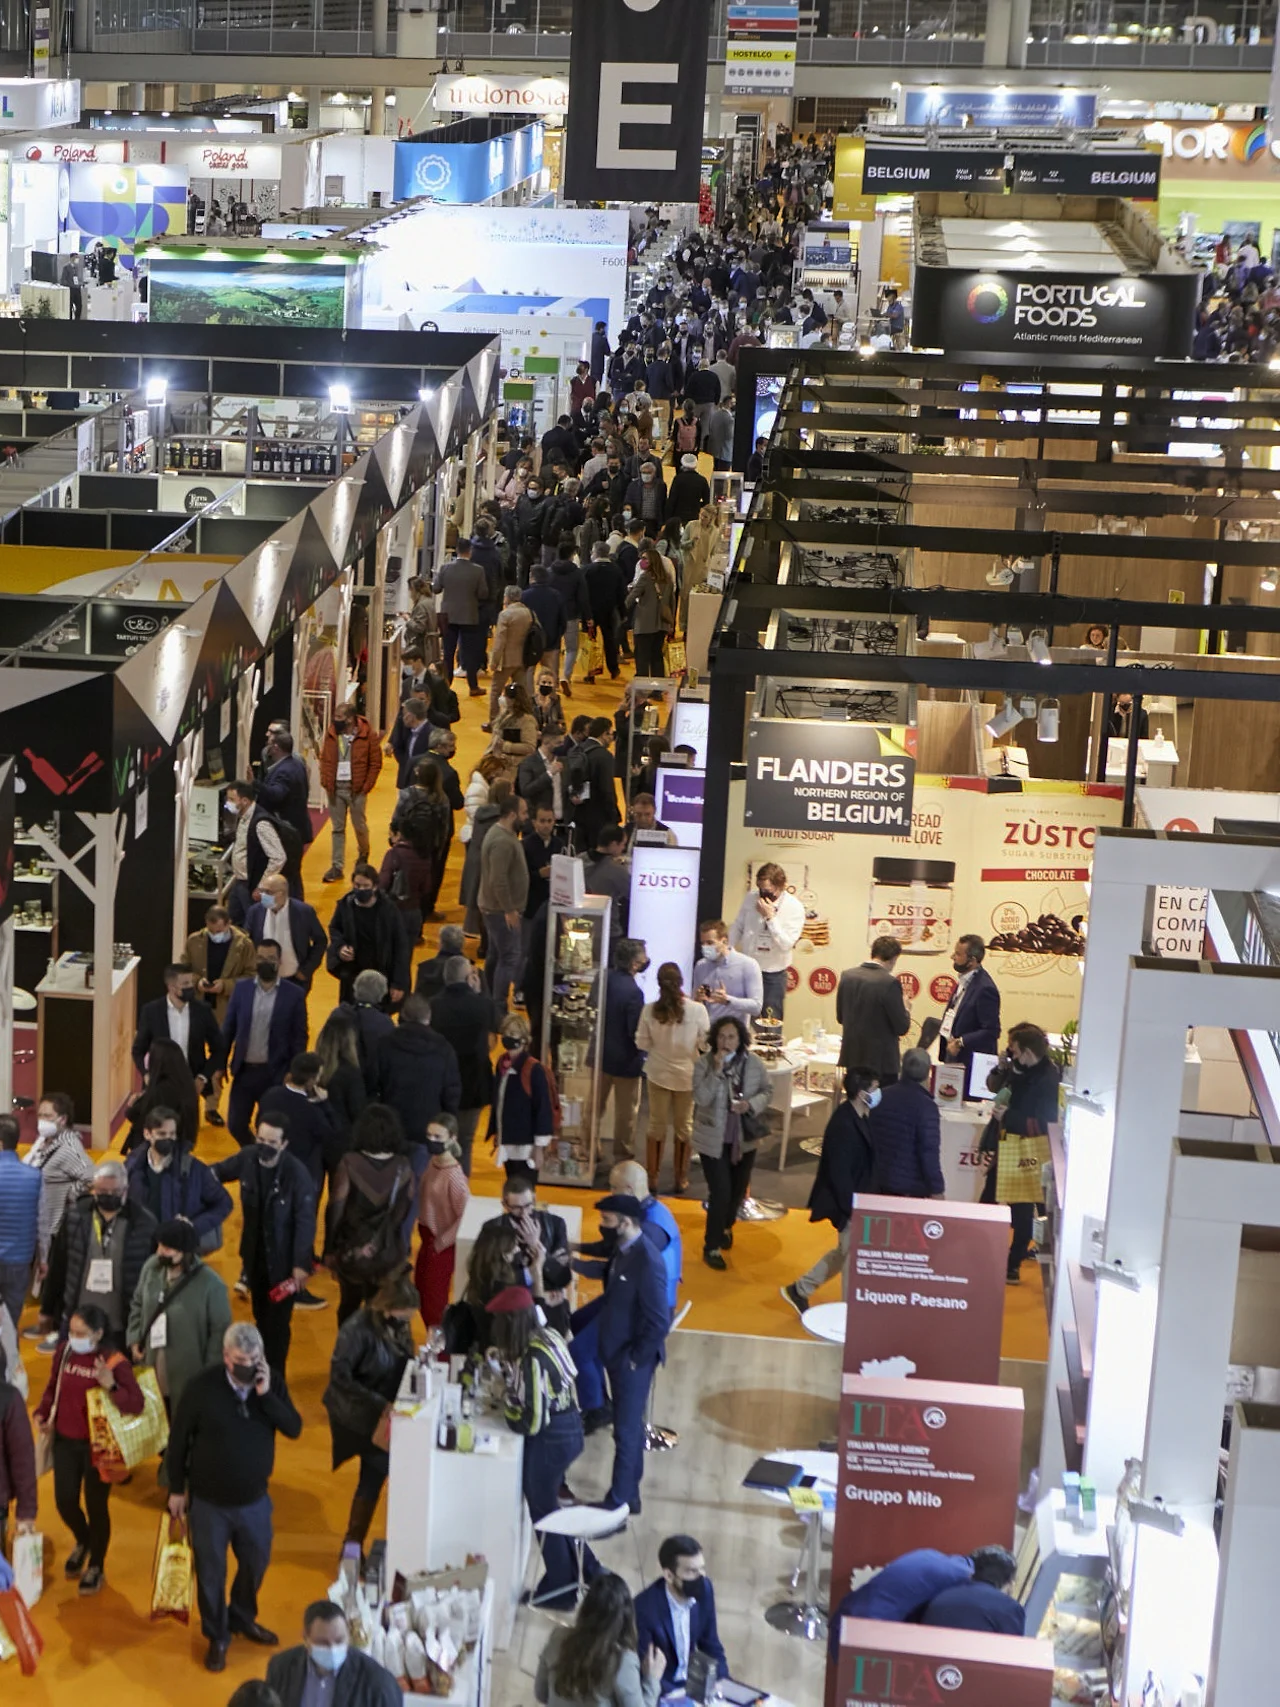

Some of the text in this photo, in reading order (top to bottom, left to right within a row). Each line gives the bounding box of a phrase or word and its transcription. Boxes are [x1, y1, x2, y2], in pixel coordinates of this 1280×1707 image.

[732, 50, 773, 58] HOSTELCO
[595, 62, 680, 171] E
[53, 144, 97, 159] Poland
[202, 148, 248, 163] Poland
[867, 166, 931, 180] BELGIUM
[1090, 171, 1156, 185] BELGIUM
[1016, 284, 1147, 308] PORTUGAL
[1014, 305, 1098, 328] FOODS
[1013, 332, 1143, 345] Atlantic meets Mediterranean
[756, 756, 907, 788] FLANDERS
[794, 787, 906, 802] NORTHERN REGION OF
[806, 802, 904, 826] BELGIUM
[914, 830, 944, 845] LOVE
[1003, 818, 1097, 849] ZÙSTO
[1001, 849, 1036, 858] SUGAR
[638, 871, 692, 889] ZÙSTO
[1025, 869, 1076, 881] CHOCOLATE
[1158, 896, 1182, 911] EN
[1154, 937, 1192, 953] CON
[857, 1249, 930, 1263] ITALIAN TRADE AGENCY
[855, 1288, 969, 1310] Liquore Paesano
[846, 1439, 931, 1456] ITALIAN TRADE AGENCY
[844, 1483, 943, 1509] Gruppo Milo
